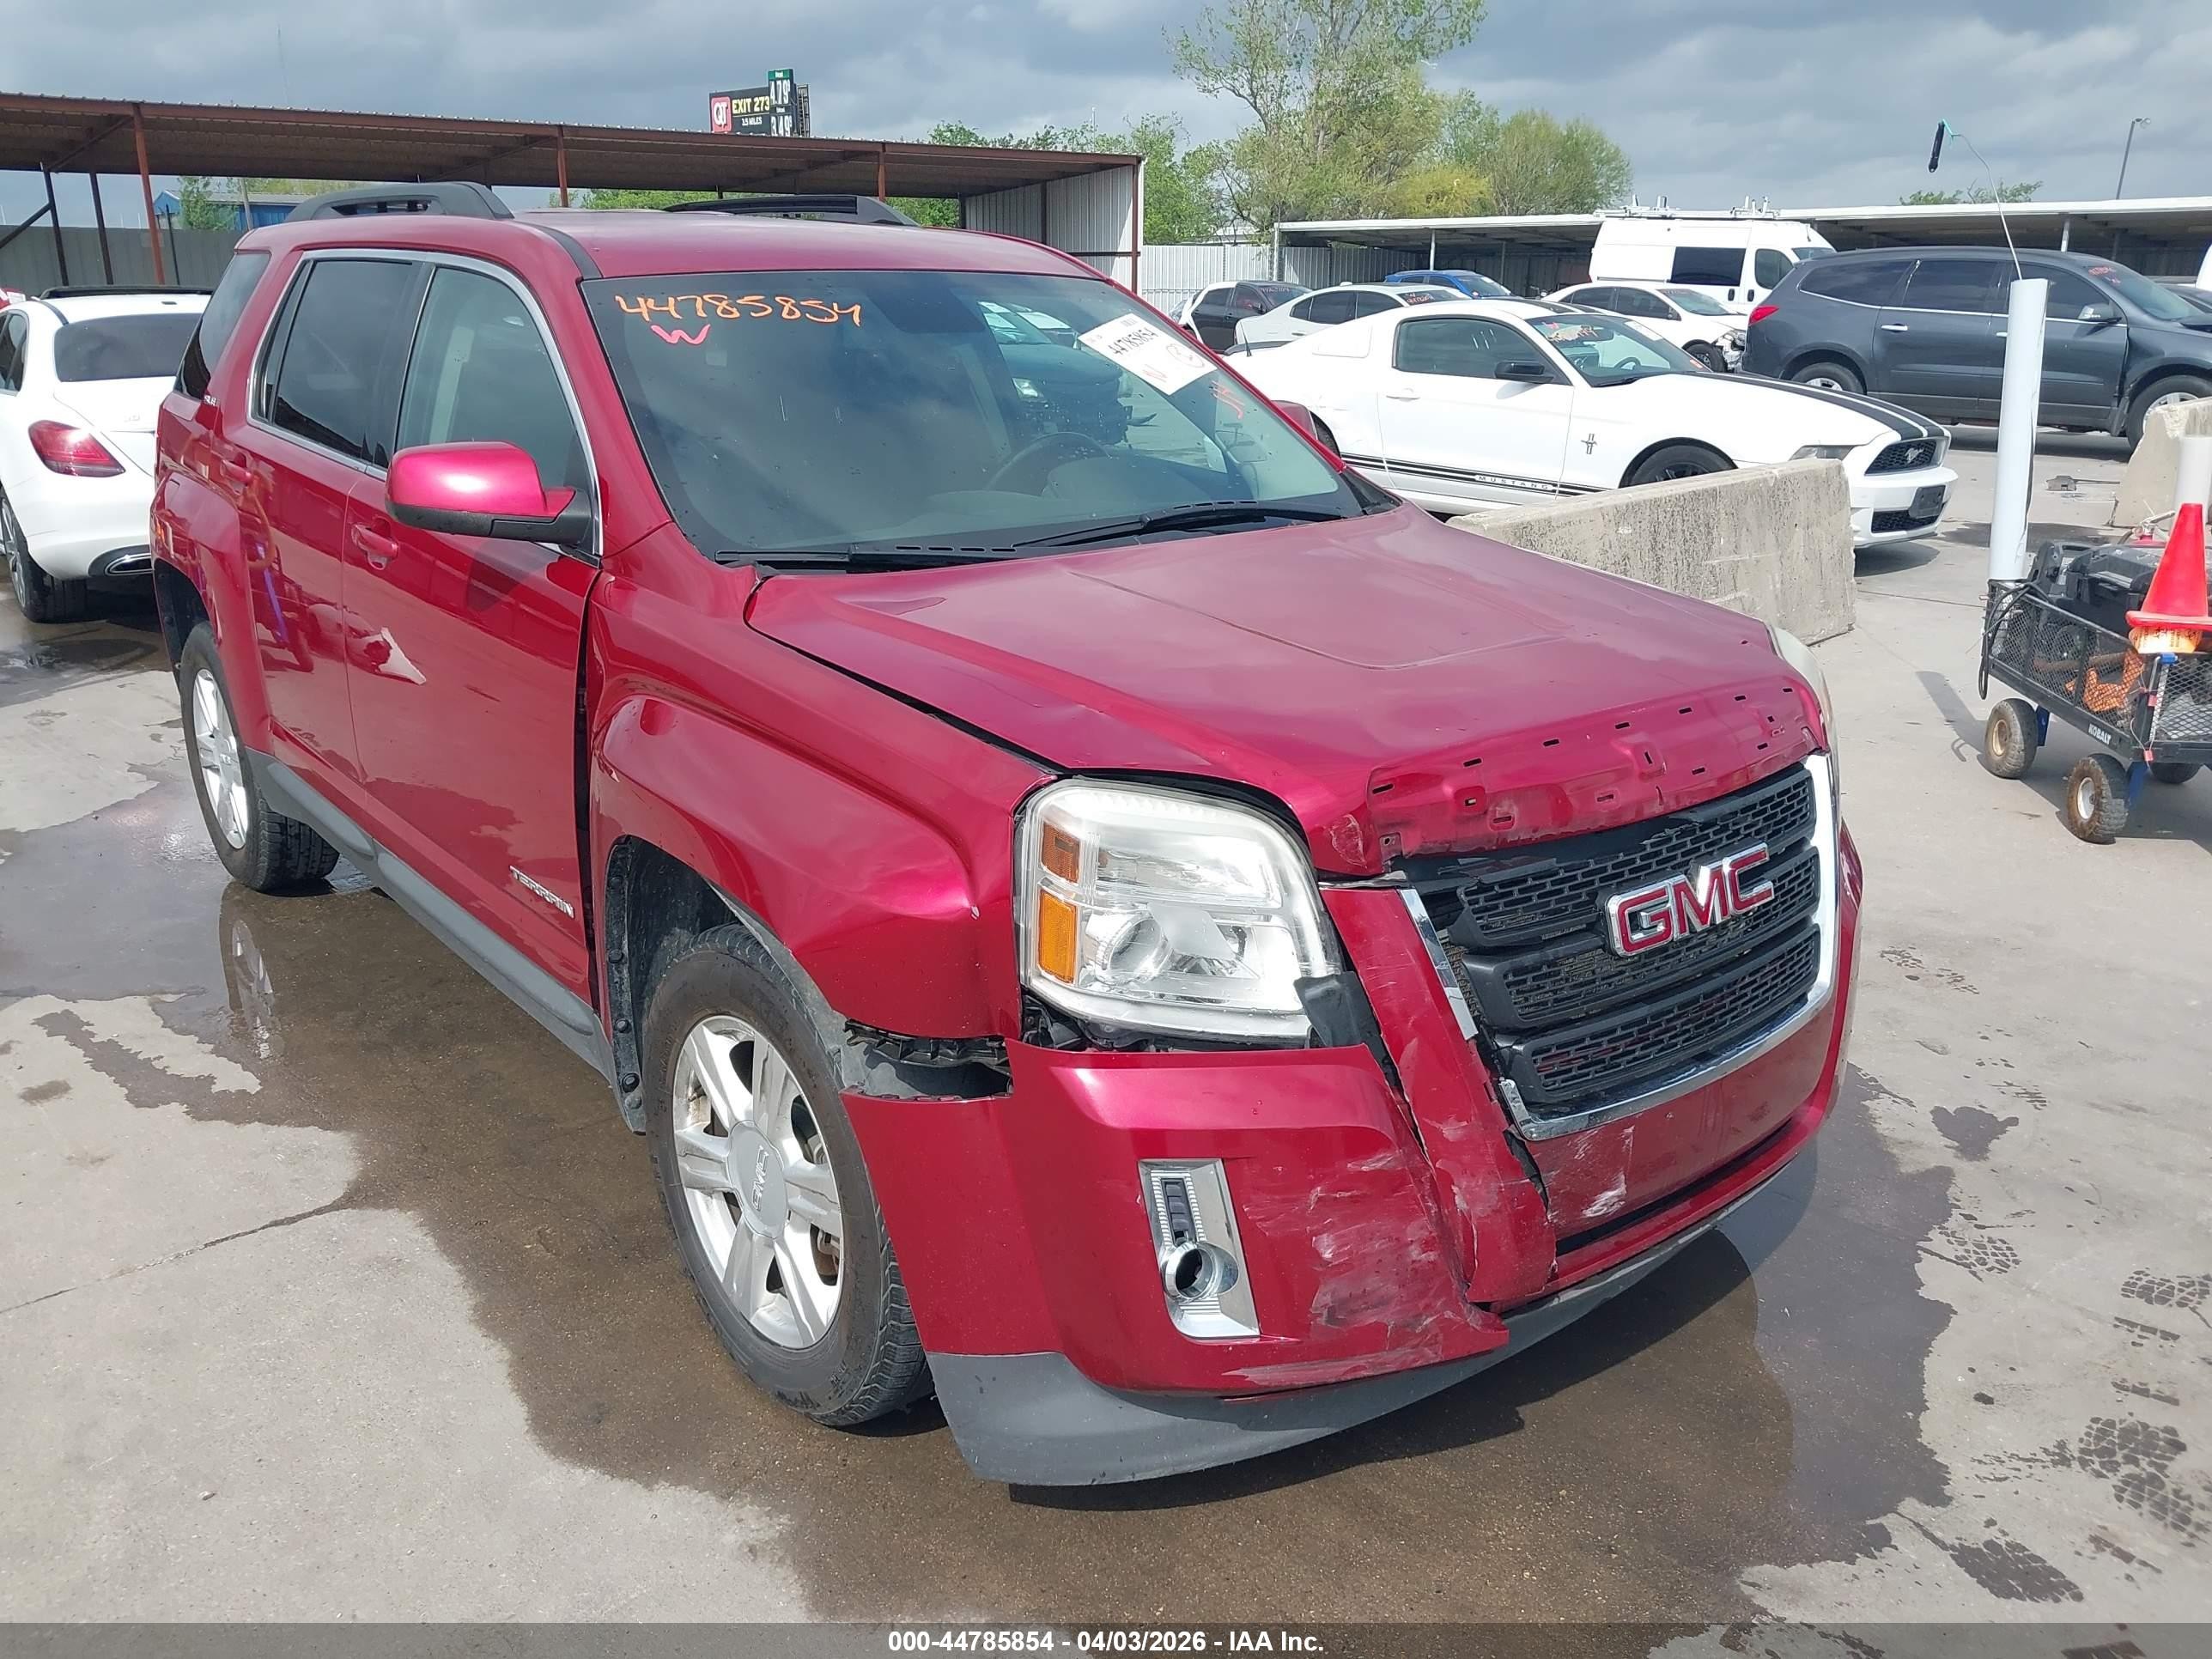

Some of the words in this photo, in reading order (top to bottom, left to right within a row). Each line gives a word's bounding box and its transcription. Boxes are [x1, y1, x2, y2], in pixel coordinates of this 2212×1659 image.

[713, 101, 728, 125] QT
[732, 98, 752, 114] EXIT
[754, 95, 769, 112] 273
[615, 294, 861, 327] 44785854
[650, 324, 711, 344] W
[1107, 326, 1159, 356] 44785854
[1479, 476, 1548, 489] MUSTANG
[2088, 723, 2112, 744] KOBALT
[509, 865, 574, 919] TERRAIN
[1606, 842, 1774, 957] GMC
[751, 1145, 769, 1212] GMC
